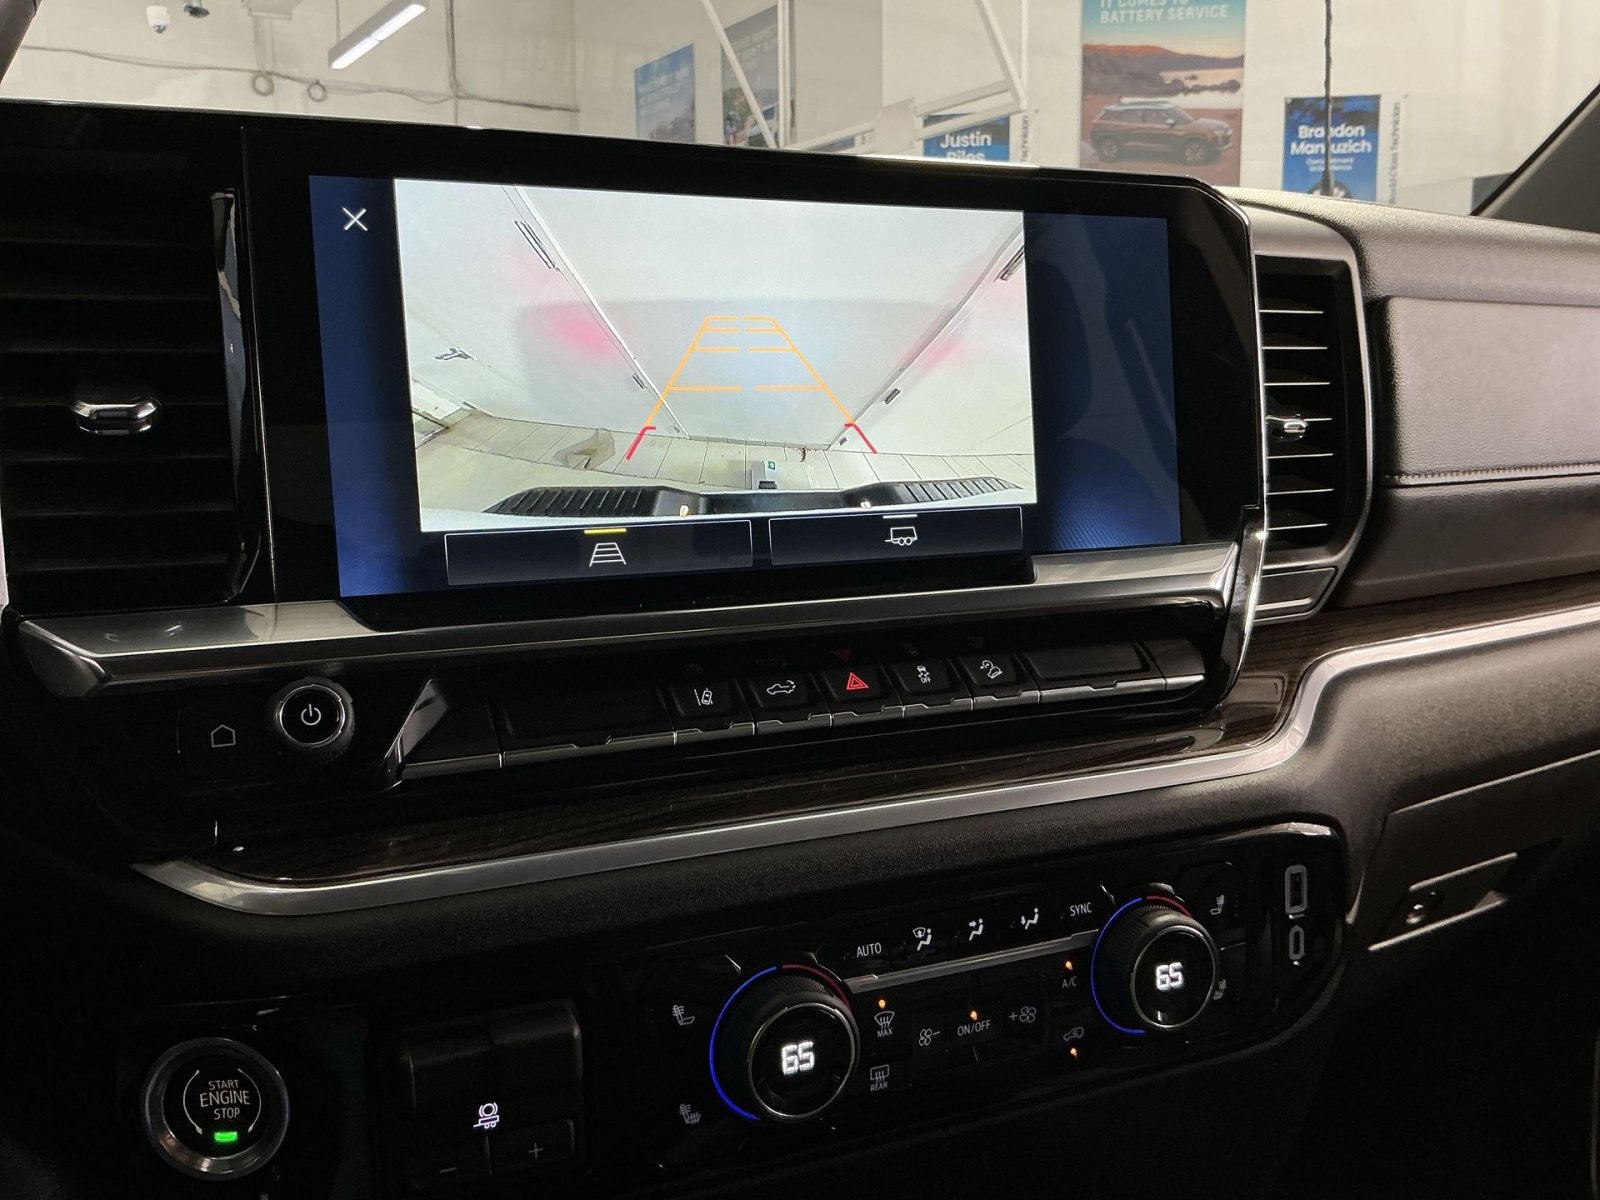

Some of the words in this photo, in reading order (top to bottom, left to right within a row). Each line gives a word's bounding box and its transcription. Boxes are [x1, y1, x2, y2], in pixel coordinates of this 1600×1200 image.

[1100, 9, 1164, 24] BATTERY
[1167, 4, 1229, 20] SERVICE
[940, 130, 992, 148] Justin
[1069, 902, 1093, 917] SYNC
[856, 942, 882, 958] AUTO
[1061, 976, 1078, 989] A/C
[1155, 961, 1184, 992] 65
[877, 1026, 893, 1038] MAX
[957, 1019, 991, 1037] ON/OFF
[781, 1041, 815, 1076] 65
[208, 1079, 239, 1091] START
[870, 1081, 888, 1092] REAR
[199, 1089, 251, 1108] ENGINE
[213, 1106, 241, 1121] STOP
